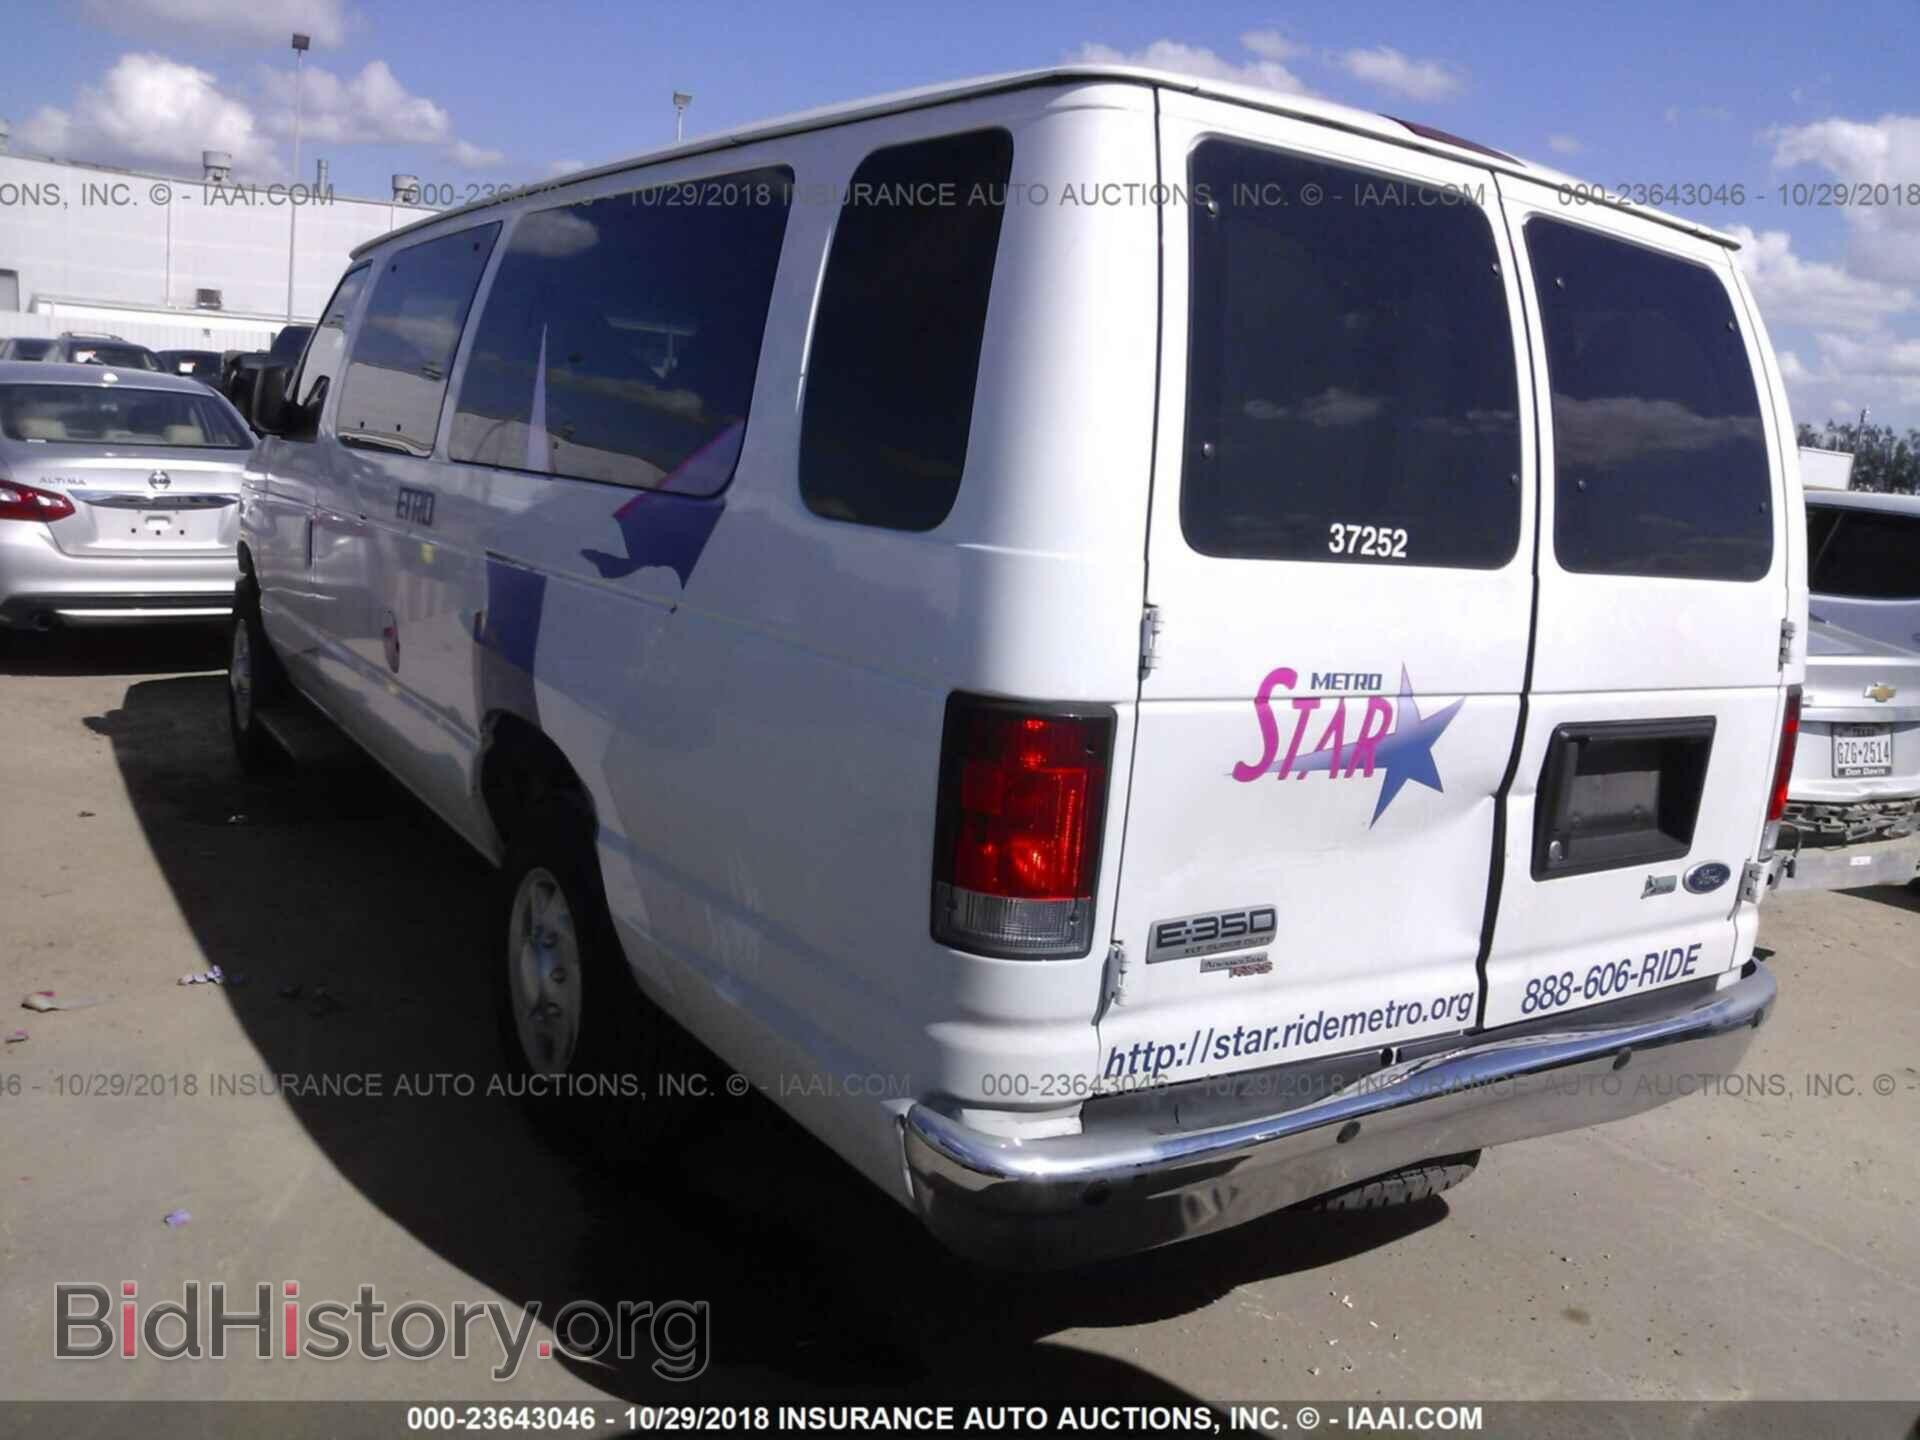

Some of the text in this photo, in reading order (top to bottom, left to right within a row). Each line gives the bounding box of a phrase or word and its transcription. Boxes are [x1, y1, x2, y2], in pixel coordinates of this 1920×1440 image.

[1328, 523, 1409, 558] 37252
[1310, 672, 1383, 690] METRO
[1232, 667, 1393, 782] STAR
[1521, 943, 1702, 1015] 888-606-RIDE
[1104, 992, 1474, 1080] http://star.ridemetro.org
